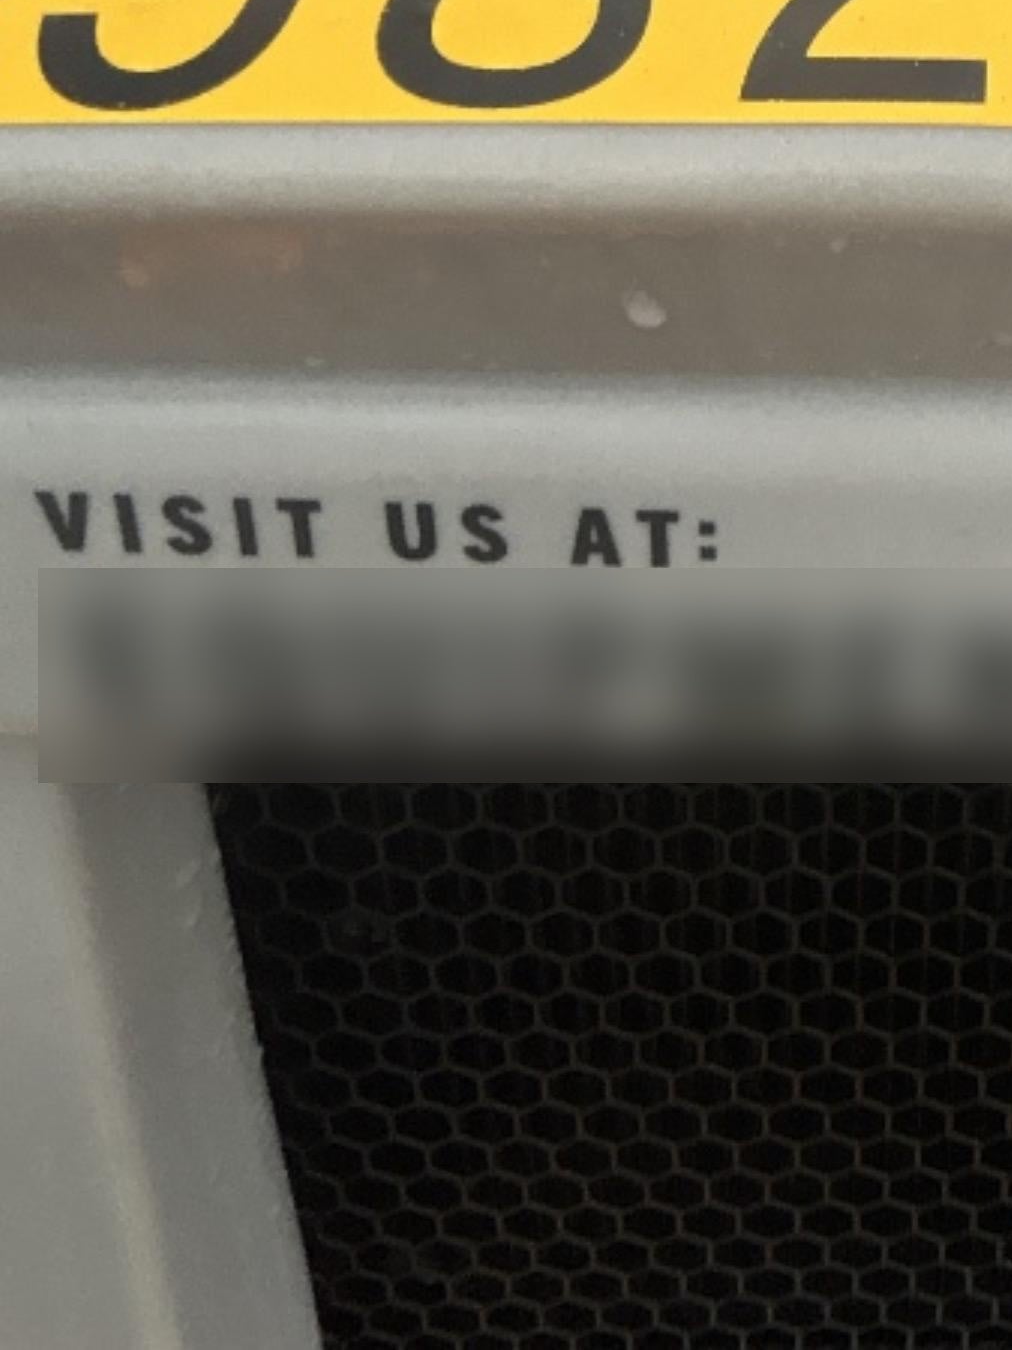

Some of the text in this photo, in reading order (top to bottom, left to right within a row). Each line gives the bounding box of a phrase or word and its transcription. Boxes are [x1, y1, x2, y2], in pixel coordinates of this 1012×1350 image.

[36, 491, 719, 568] VISIT US AT:
